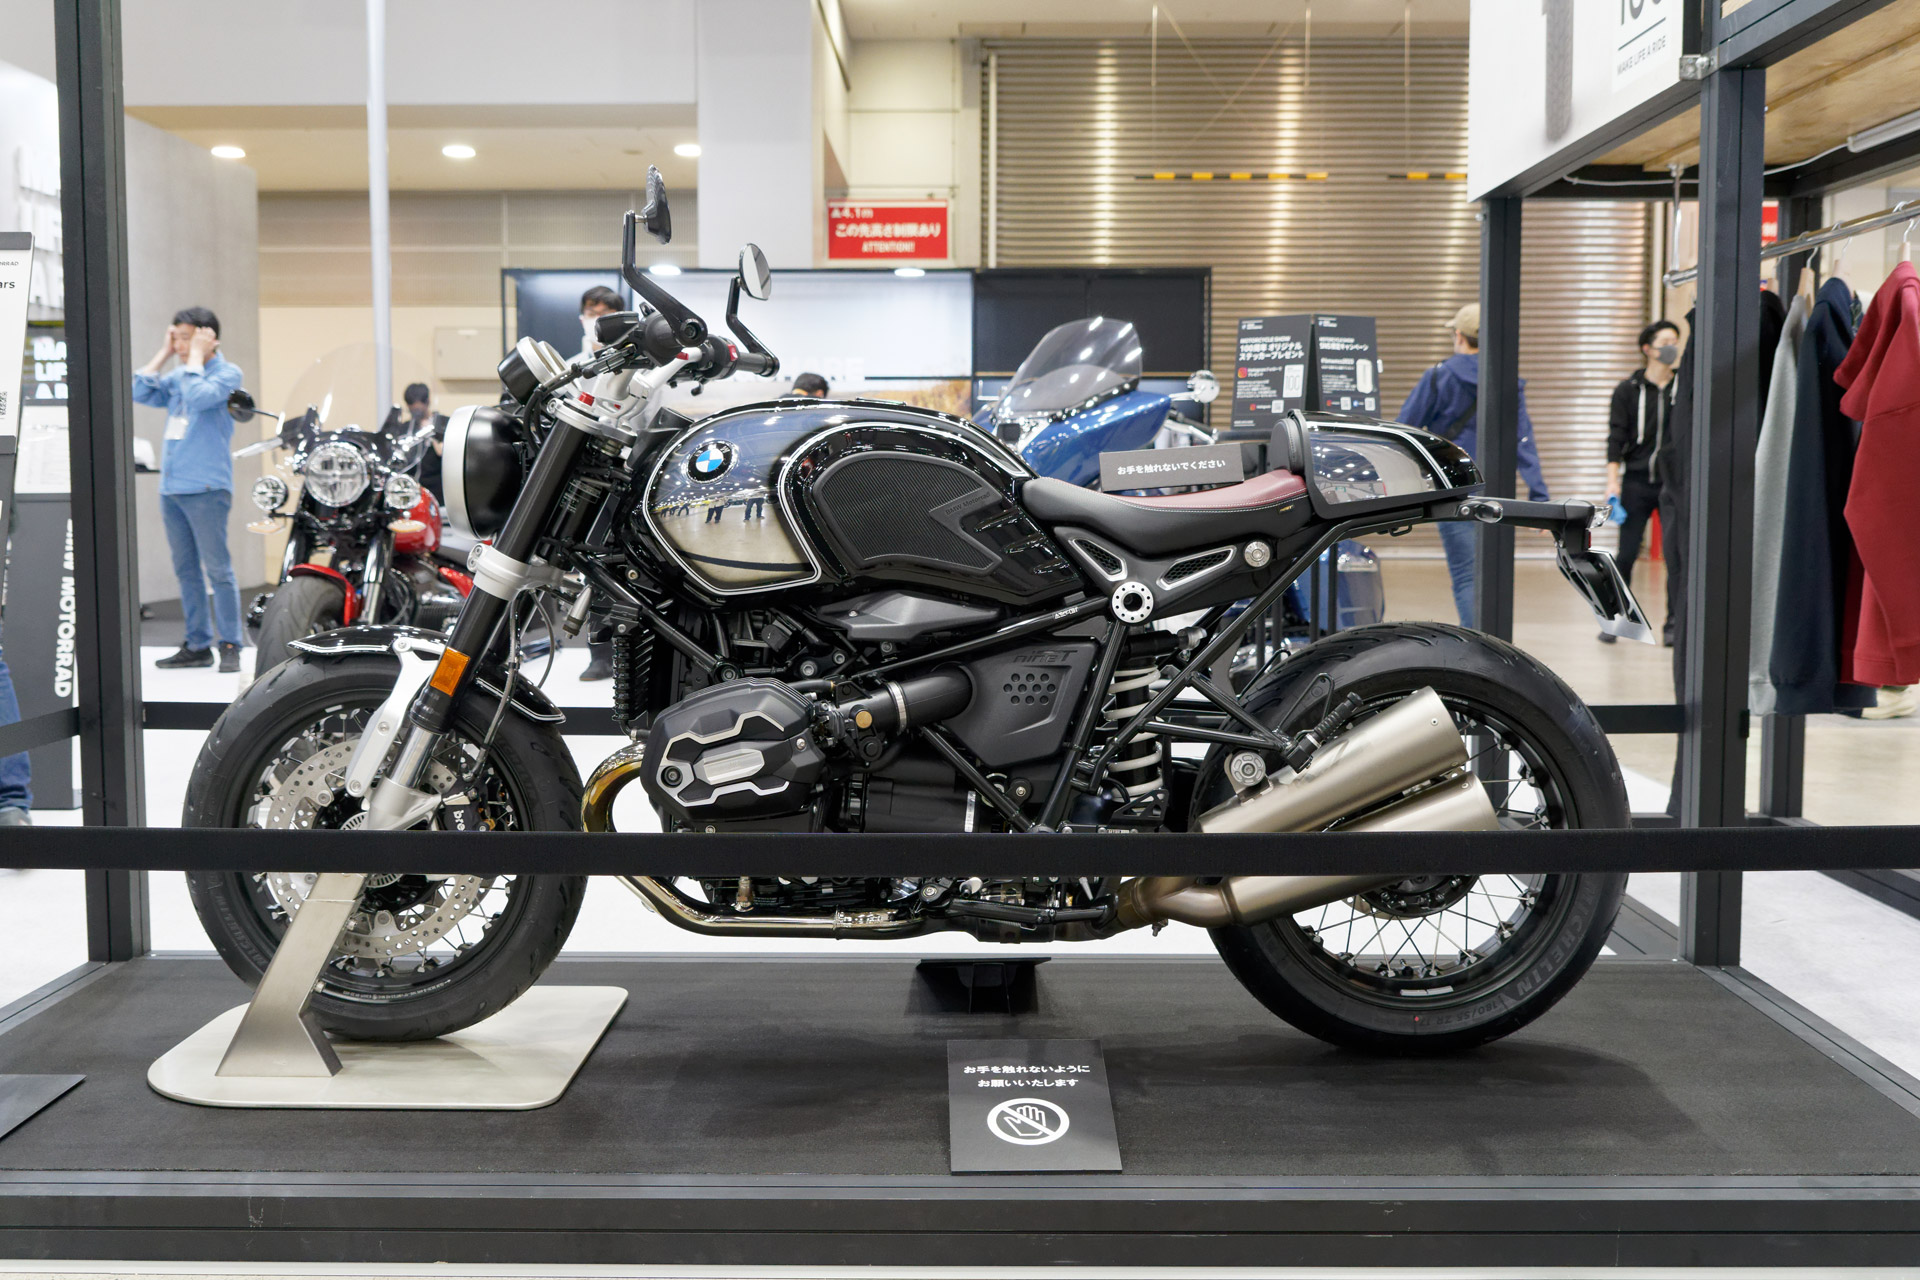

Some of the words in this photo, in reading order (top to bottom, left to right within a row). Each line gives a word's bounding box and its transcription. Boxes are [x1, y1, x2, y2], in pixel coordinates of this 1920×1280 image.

[1116, 459, 1226, 476] お手を触れないでください
[54, 576, 76, 698] MOTORRAD
[1516, 881, 1598, 997] MICHELIN
[1457, 1000, 1499, 1022] 180/55
[963, 1065, 1091, 1075] お手を触れないように
[977, 1079, 1079, 1088] お願いいたします
